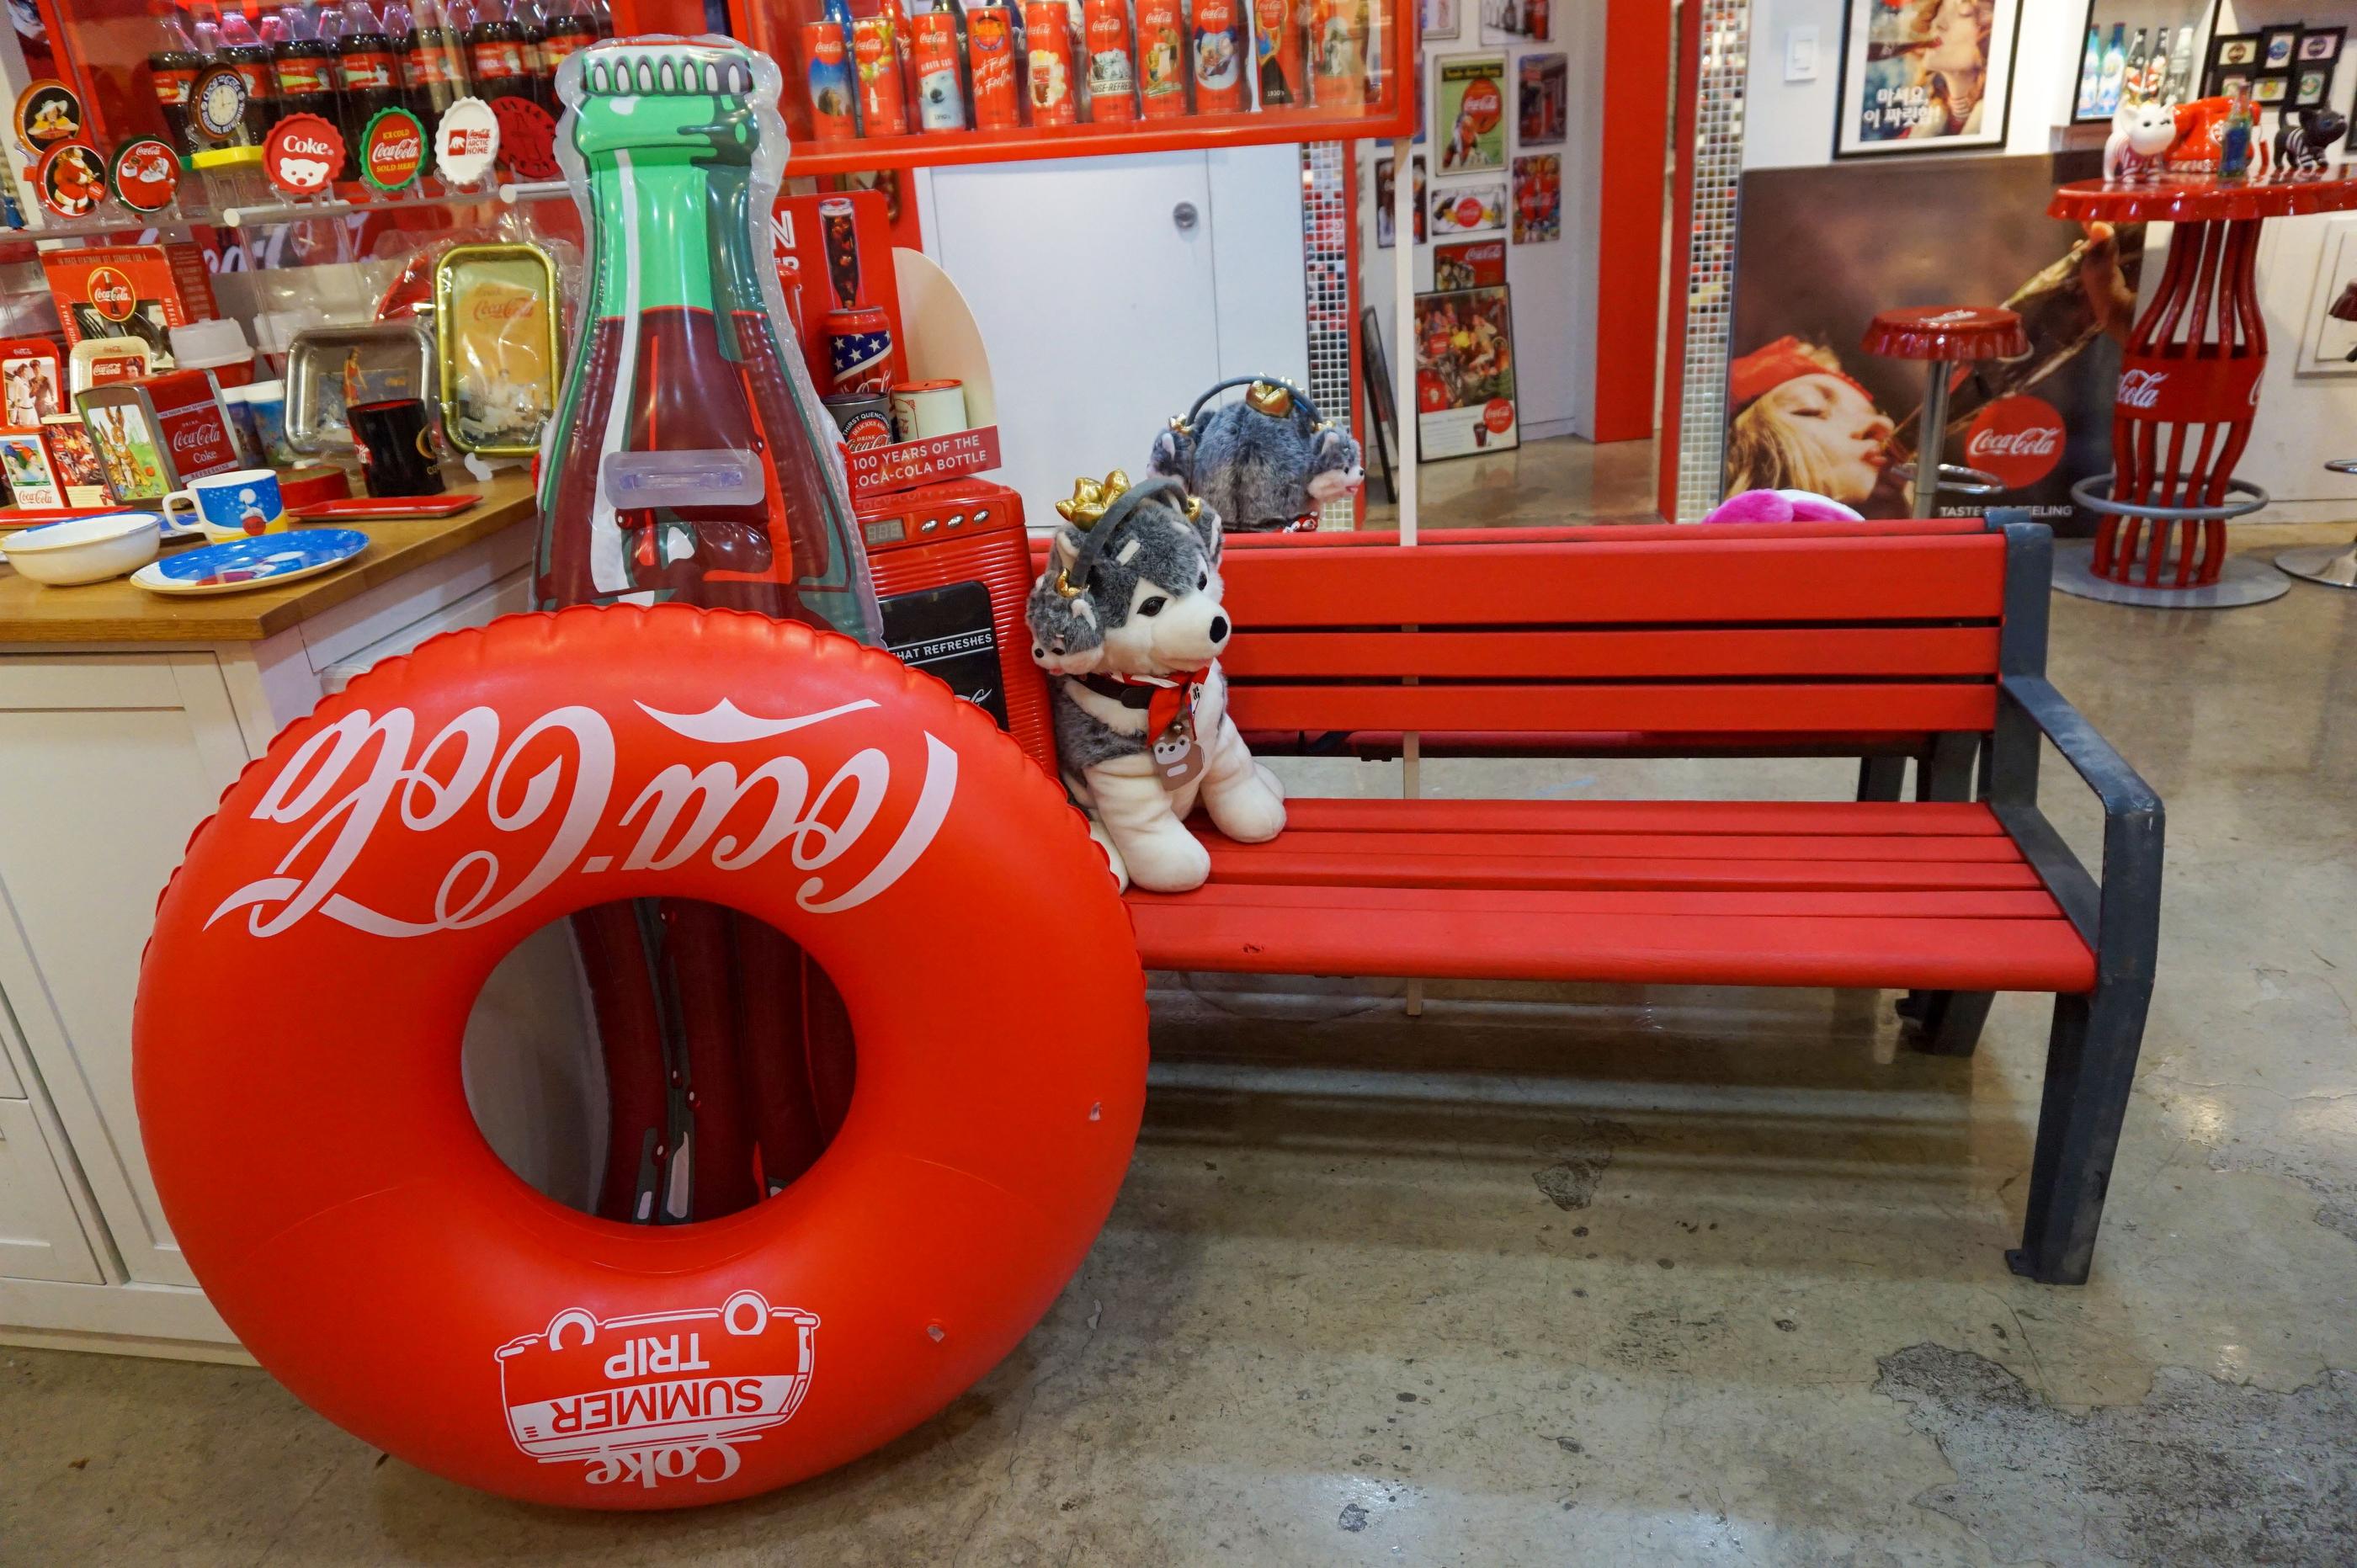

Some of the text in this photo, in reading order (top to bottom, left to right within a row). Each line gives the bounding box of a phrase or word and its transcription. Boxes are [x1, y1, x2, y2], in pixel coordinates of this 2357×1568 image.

[1864, 108, 1881, 130] 이
[393, 128, 410, 138] COLD
[283, 136, 328, 155] Coke
[372, 137, 419, 162] Coca-Cola
[466, 146, 488, 155] HOME
[376, 164, 396, 173] SOLD
[94, 286, 131, 302] Coca-Cola
[173, 423, 221, 452] Coca-Cola
[842, 416, 859, 436] THIRST
[853, 434, 980, 470] 100 YEARS OF THE
[1970, 427, 2061, 456] Coca-Cola
[193, 450, 217, 464] Coke
[191, 463, 230, 479] REFRESHING
[854, 449, 987, 489] OCA-COLA BOTTLE
[19, 489, 53, 505] Coca-Cola
[892, 633, 992, 661] HAT REFRESHES
[202, 697, 958, 939] Coca-Cola
[604, 1332, 710, 1379] TRIP
[550, 1379, 763, 1434] SUMMER
[584, 1442, 742, 1489] Coke
